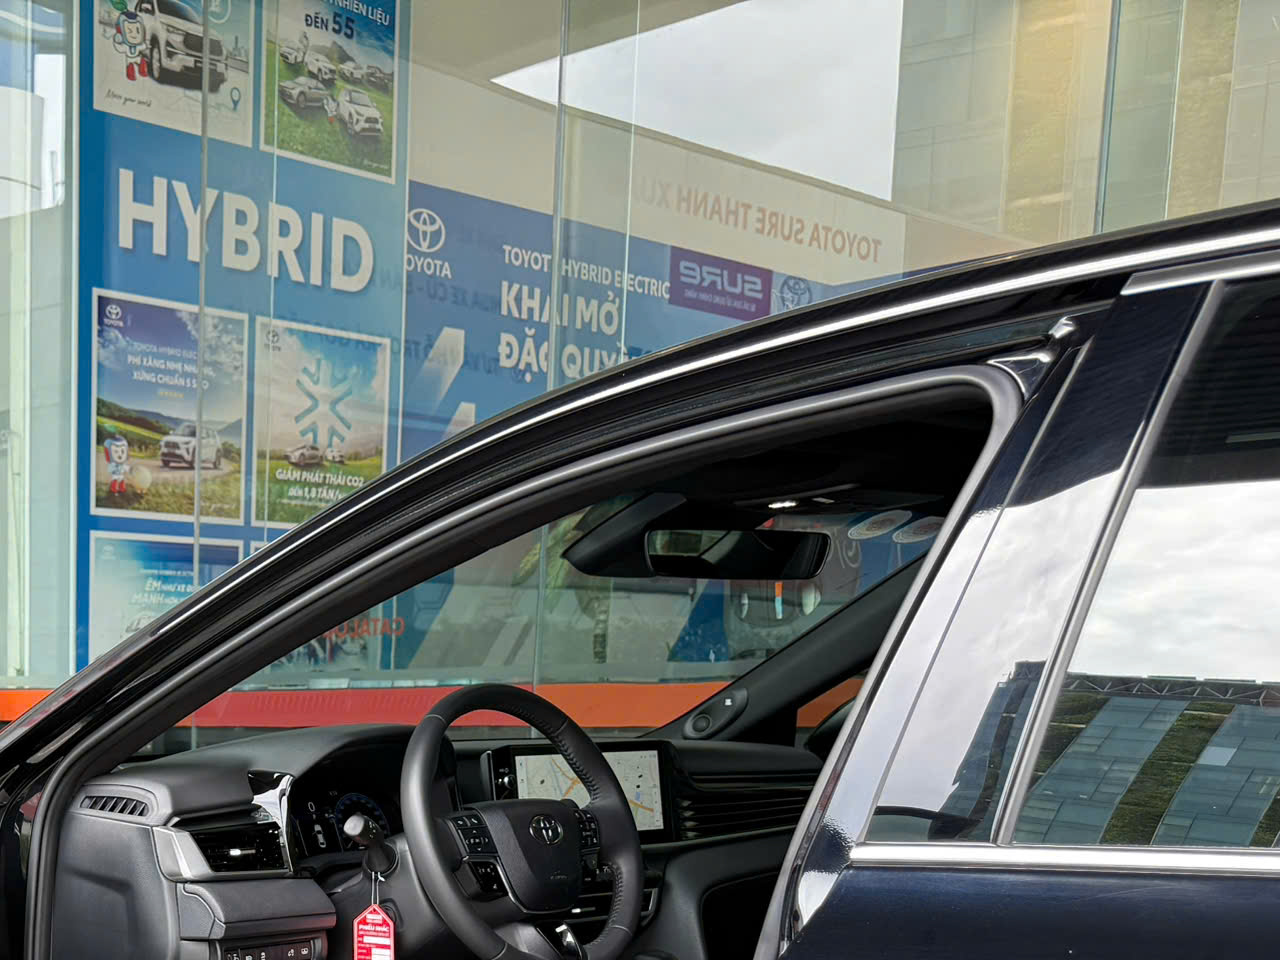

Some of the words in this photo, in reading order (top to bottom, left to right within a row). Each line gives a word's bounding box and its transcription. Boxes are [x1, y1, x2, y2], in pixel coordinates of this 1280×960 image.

[305, 12, 329, 31] ĐẾN
[332, 12, 355, 39] 55
[119, 168, 374, 293] HYBRID
[405, 257, 452, 279] OYOTA
[502, 244, 552, 273] TOYOT
[561, 258, 612, 286] HYBRID
[575, 290, 620, 336] MỞ
